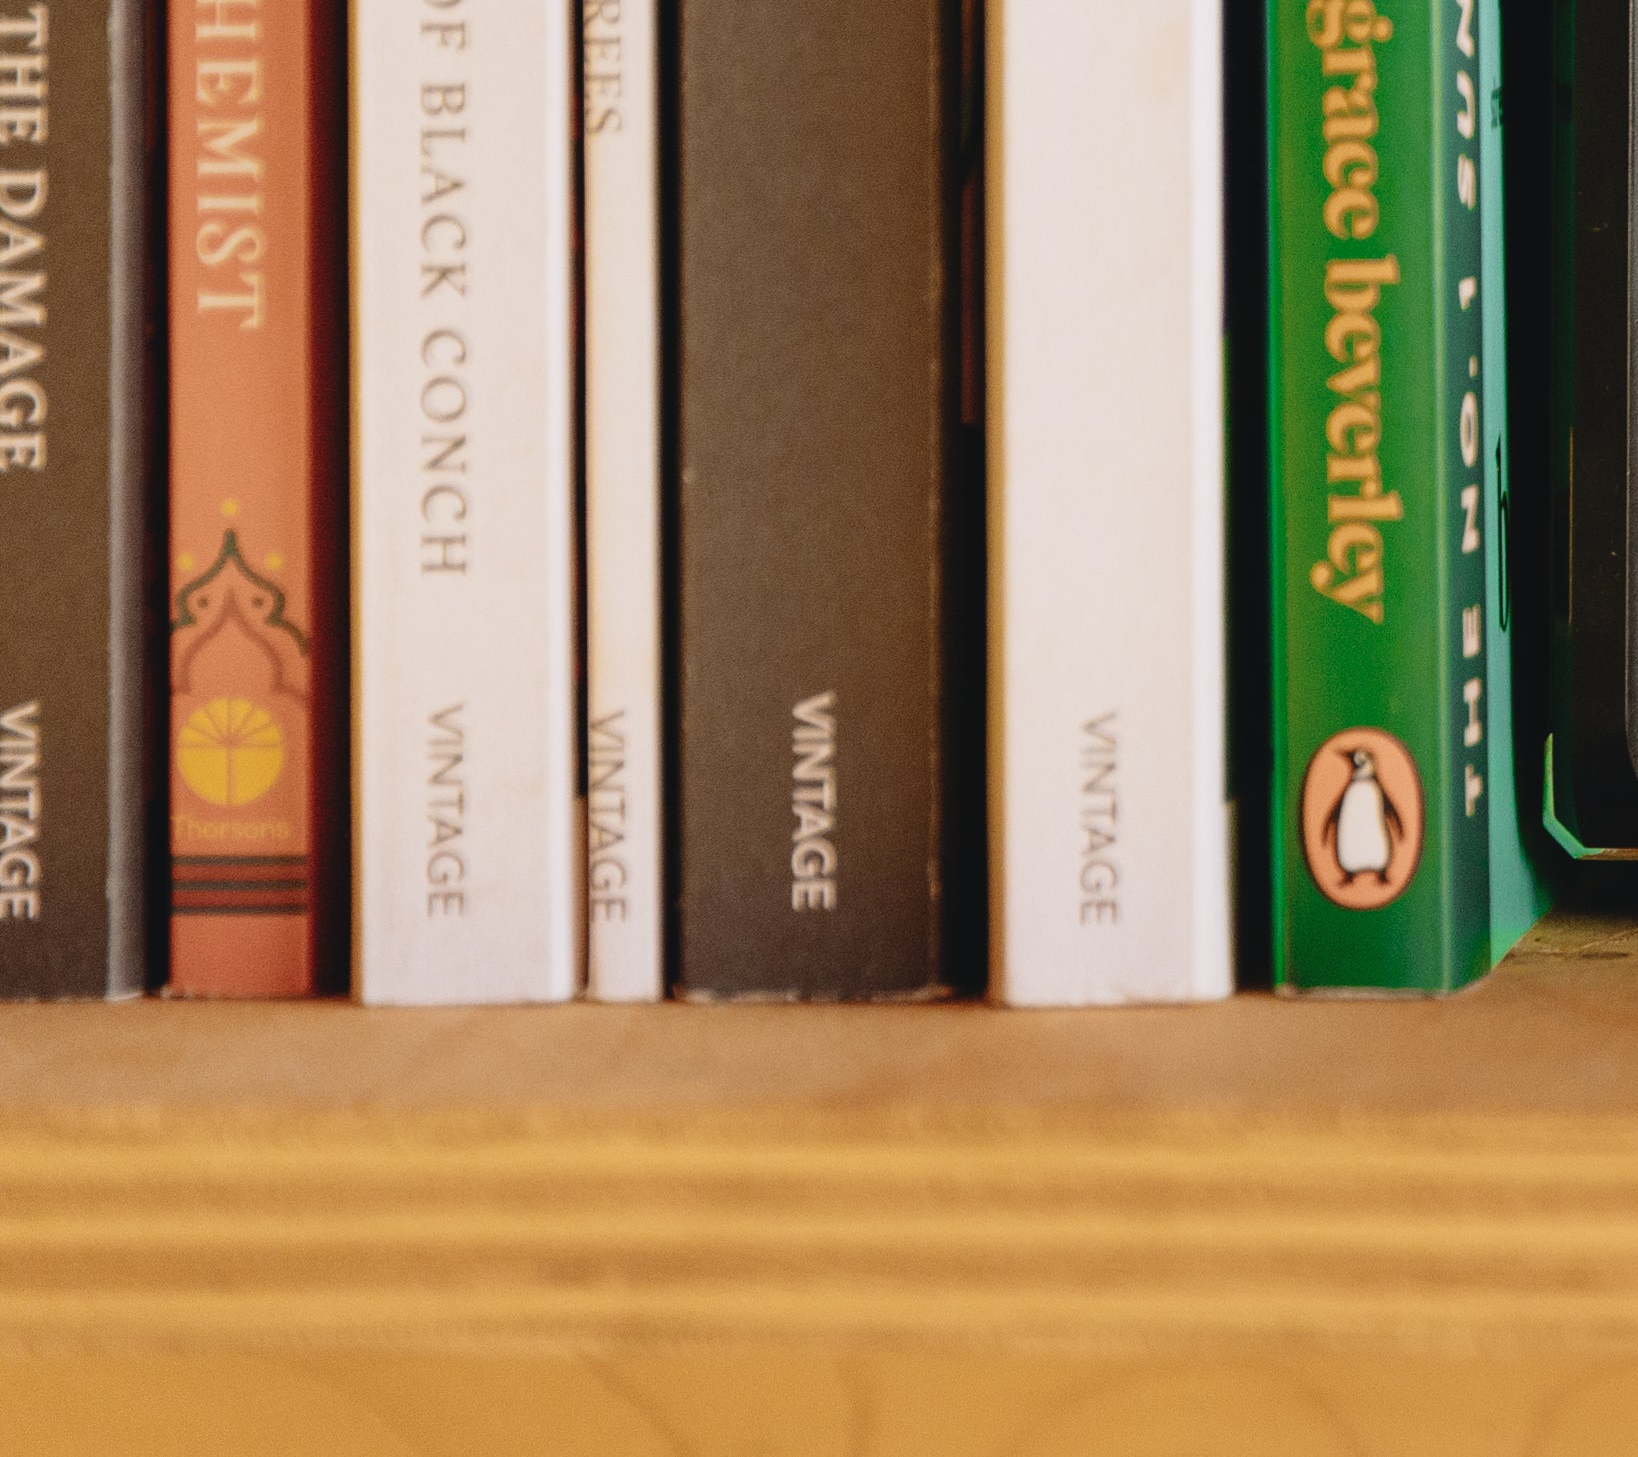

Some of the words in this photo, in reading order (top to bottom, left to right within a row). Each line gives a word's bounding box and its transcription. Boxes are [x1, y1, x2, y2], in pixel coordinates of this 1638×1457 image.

[0, 6, 46, 143] THE
[421, 83, 467, 296] BLACK
[0, 171, 44, 469] DAMAGE
[421, 329, 467, 574] CONCH
[1309, 254, 1404, 624] beverley
[0, 704, 38, 917] VINTAGE
[427, 705, 467, 917] VINTAGE
[589, 710, 627, 924] VINTAGE
[792, 693, 835, 908] VINTAGE
[1462, 604, 1484, 818] THE
[1080, 713, 1120, 924] VINTAGE
